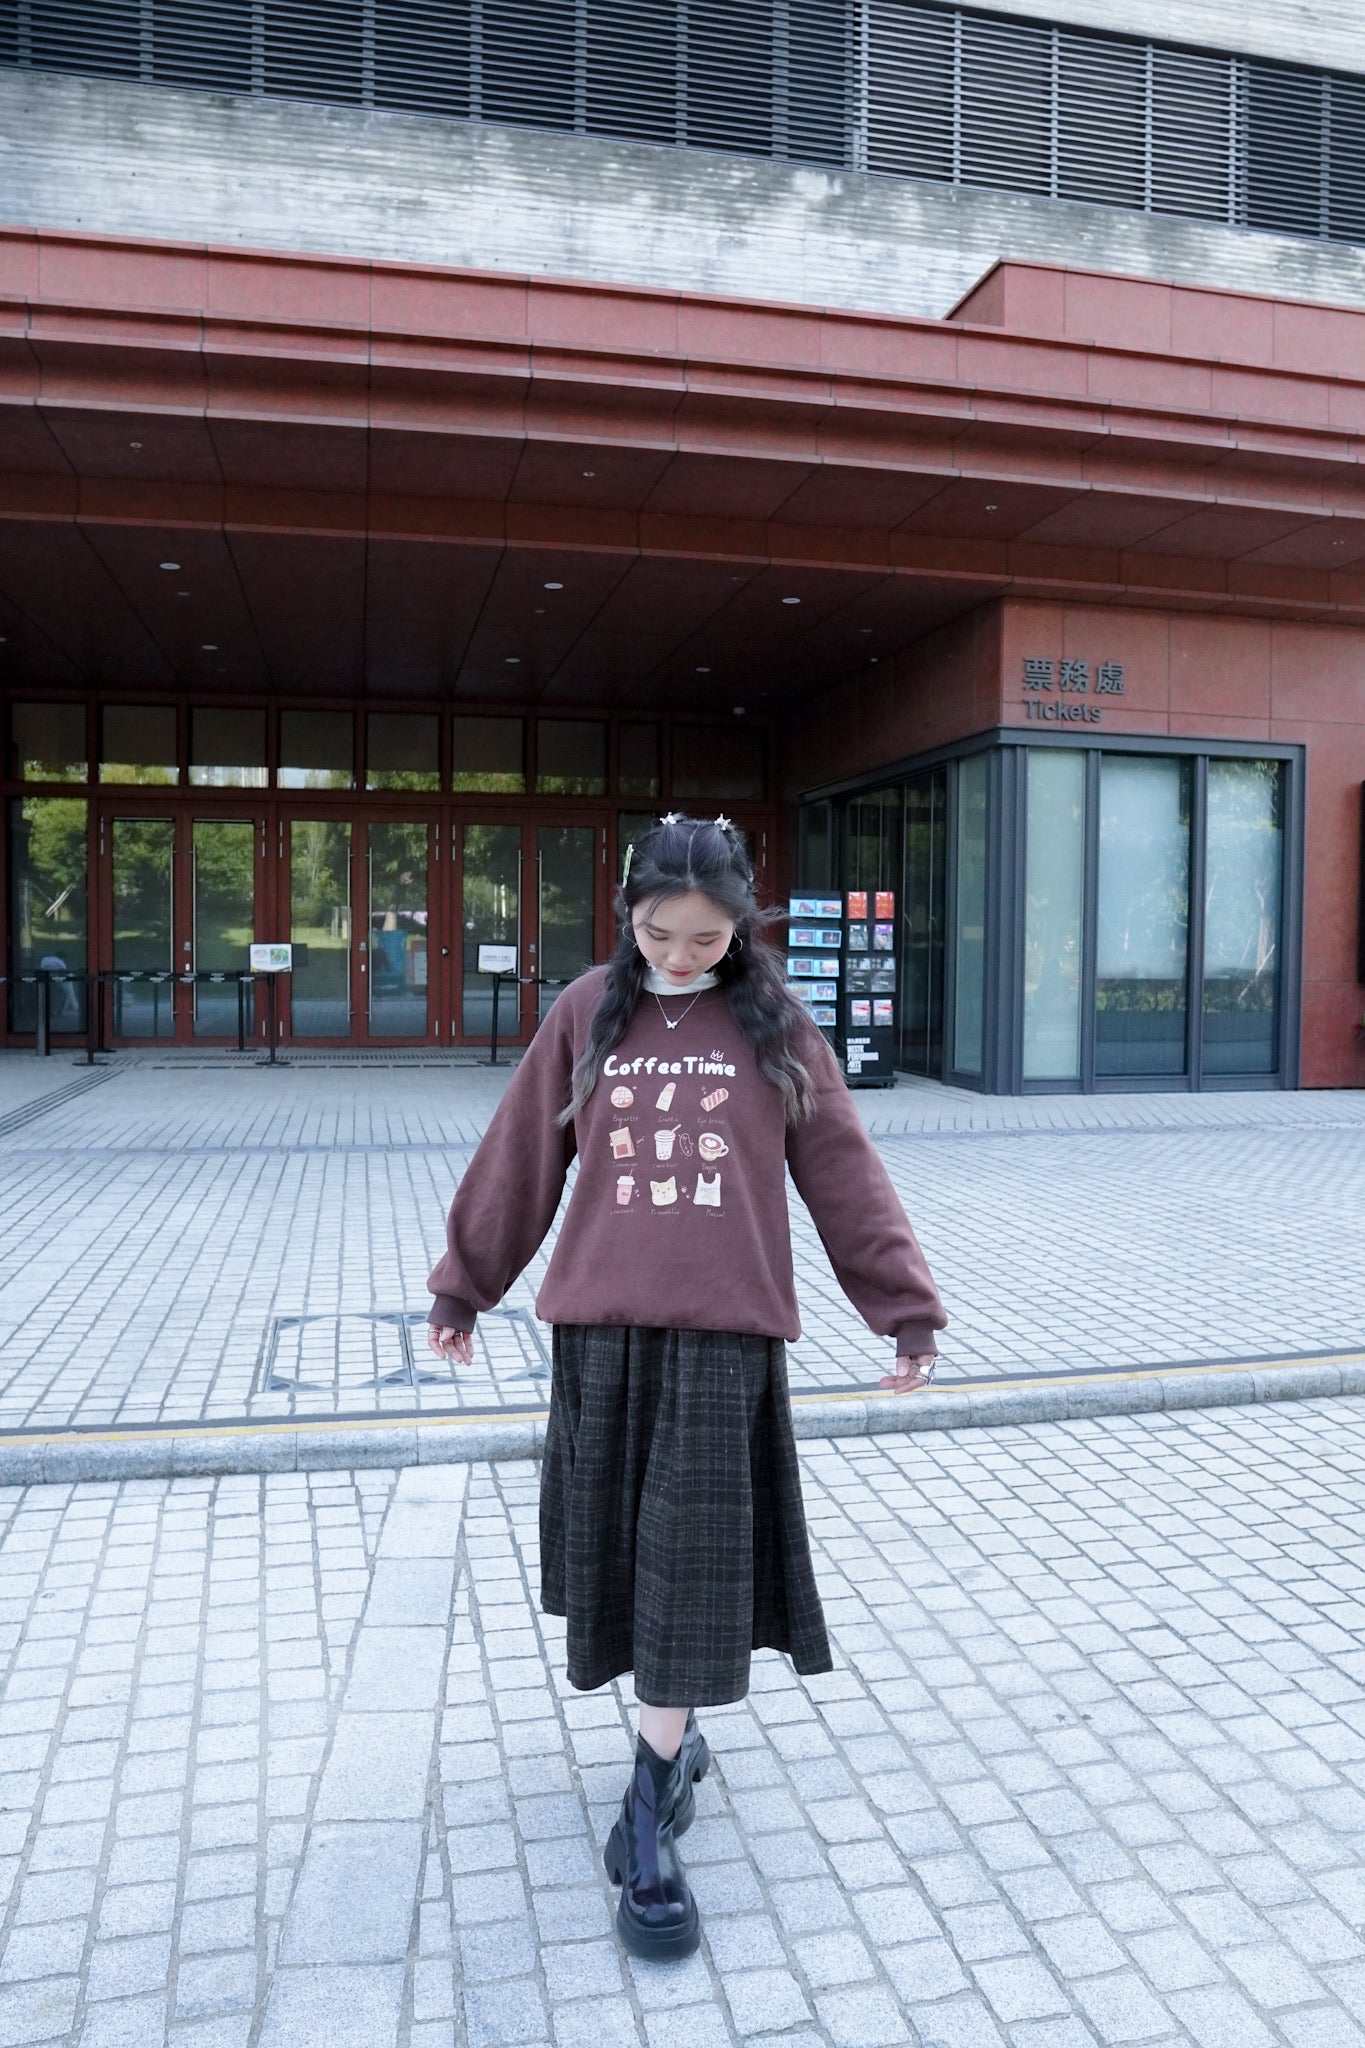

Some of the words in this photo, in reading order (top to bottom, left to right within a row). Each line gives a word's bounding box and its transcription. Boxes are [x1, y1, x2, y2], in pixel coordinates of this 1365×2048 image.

[1022, 656, 1125, 695] 票務處
[1022, 698, 1103, 723] Tickets
